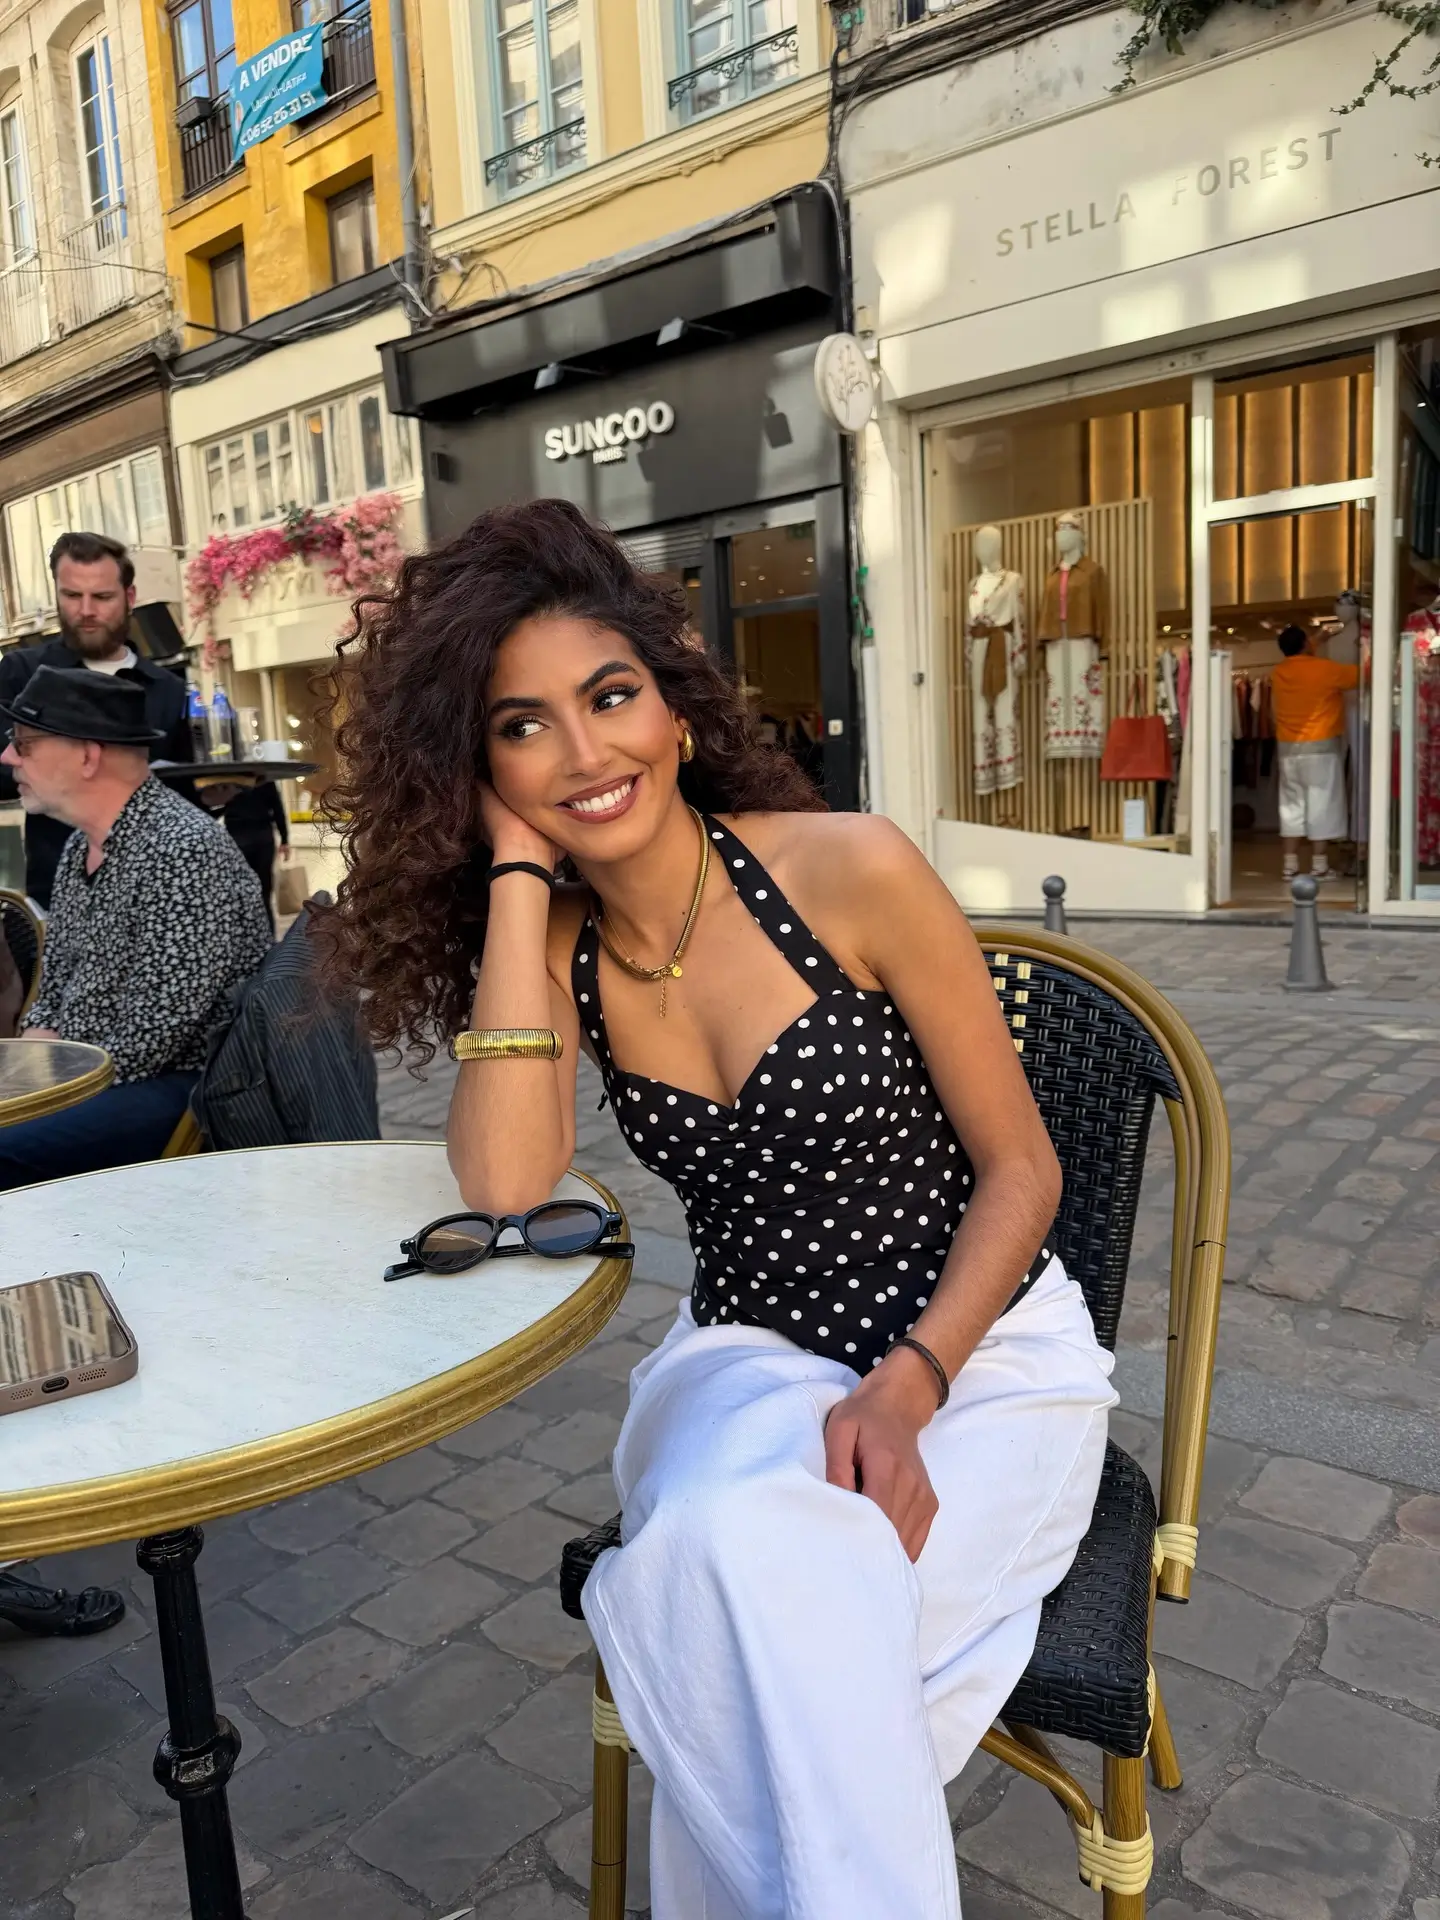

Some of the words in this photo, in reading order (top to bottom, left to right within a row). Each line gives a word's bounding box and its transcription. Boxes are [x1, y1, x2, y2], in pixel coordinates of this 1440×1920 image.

[240, 70, 250, 92] A
[251, 33, 313, 82] VENDRE
[995, 192, 1137, 257] STELLA
[1171, 127, 1342, 206] FOREST
[544, 400, 675, 460] SUNCOO
